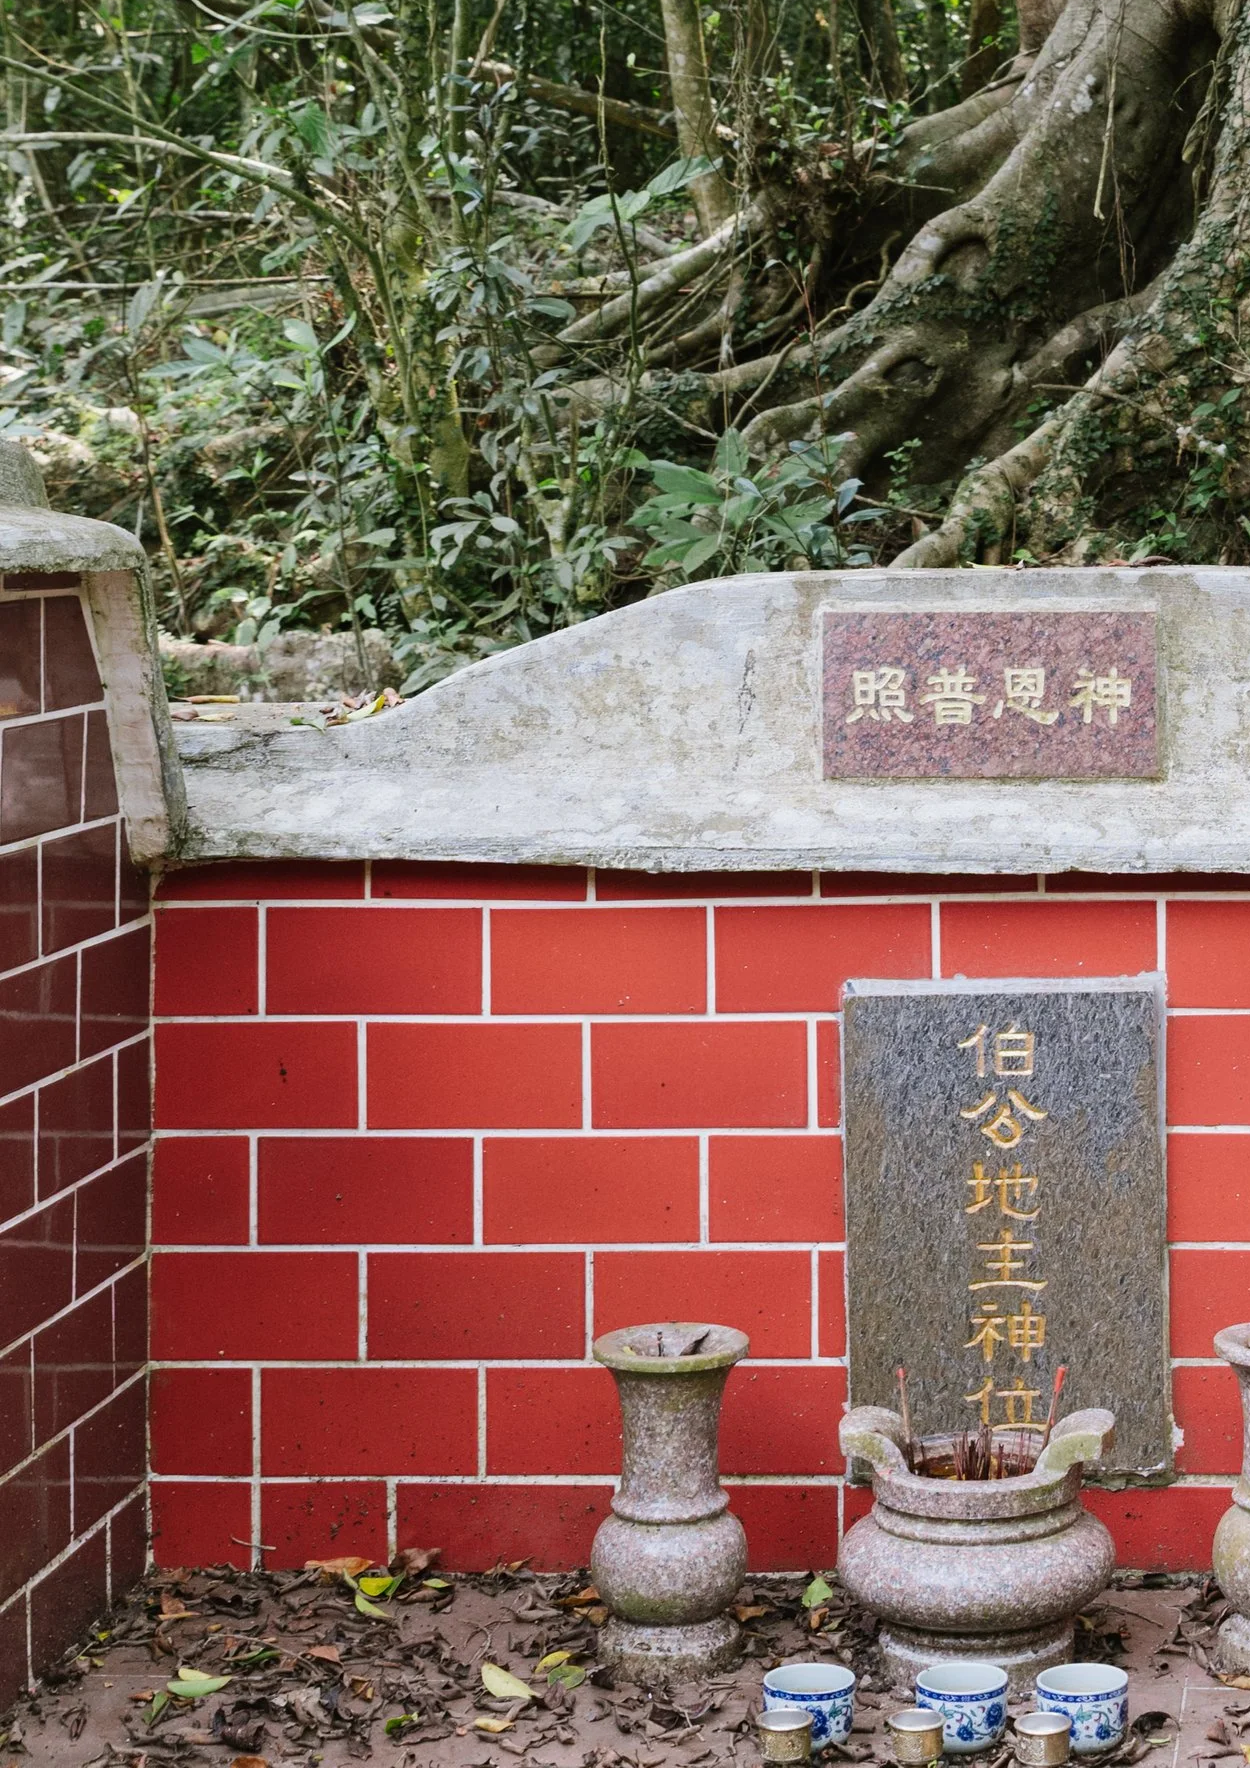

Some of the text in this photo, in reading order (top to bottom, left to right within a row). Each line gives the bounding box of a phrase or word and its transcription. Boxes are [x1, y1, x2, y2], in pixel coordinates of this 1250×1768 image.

[957, 1021, 1049, 1433] 伯公地主神位
